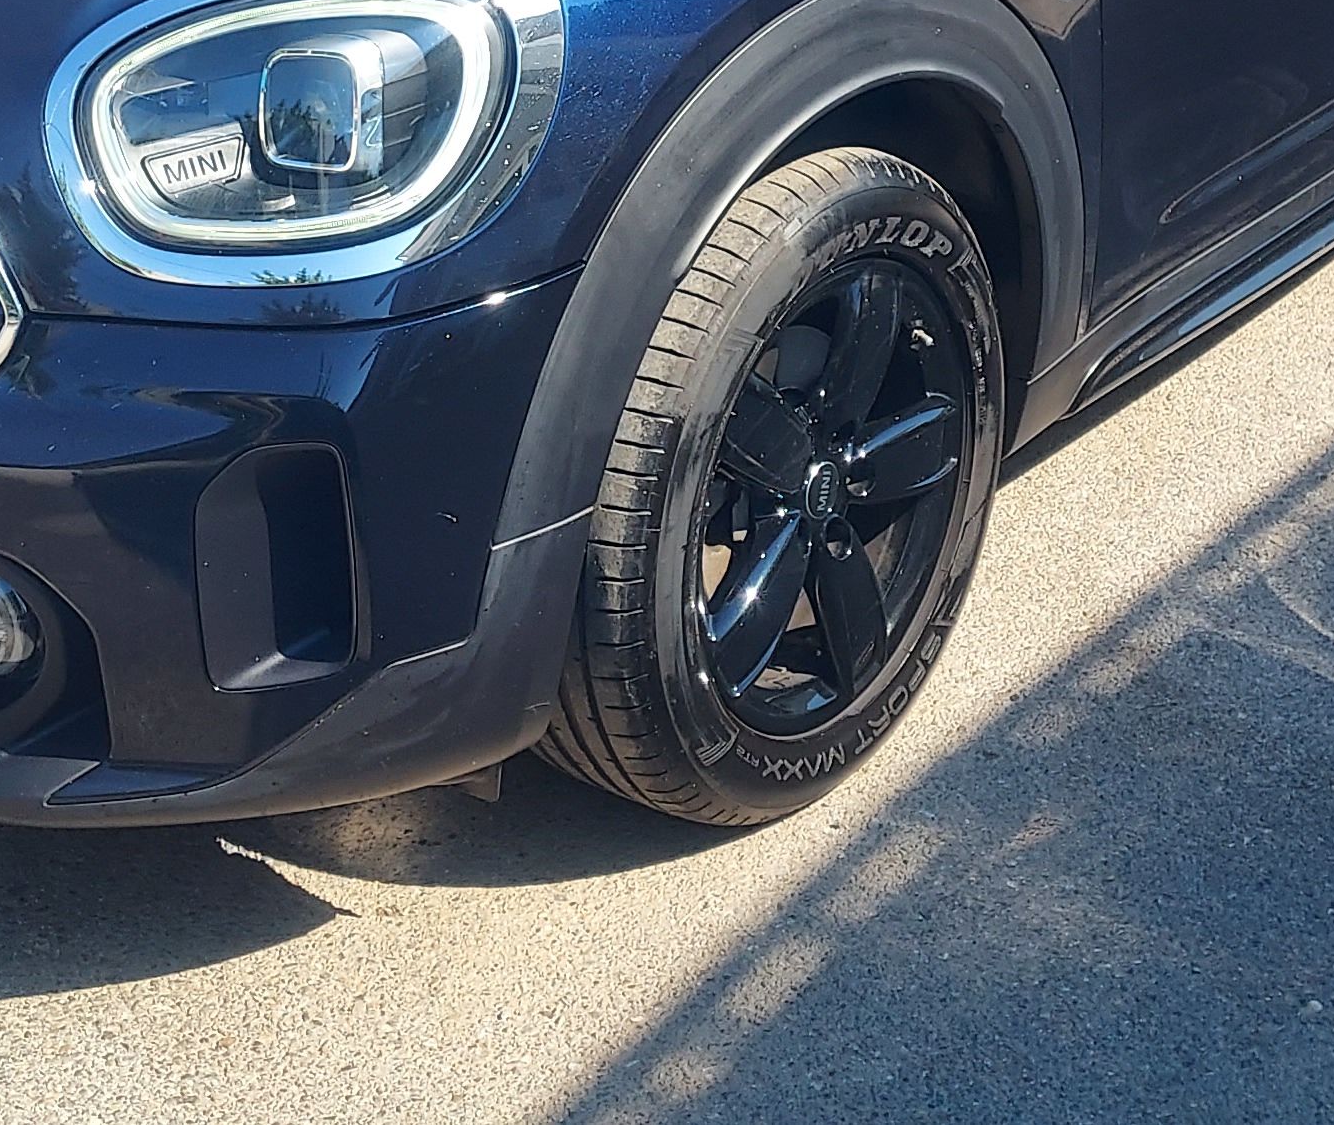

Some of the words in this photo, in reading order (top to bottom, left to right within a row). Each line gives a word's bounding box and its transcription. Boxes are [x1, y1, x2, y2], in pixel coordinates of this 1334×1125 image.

[162, 149, 227, 184] MINI
[816, 470, 832, 512] MINI
[853, 631, 943, 755] SPORT
[761, 742, 846, 781] MAXX
